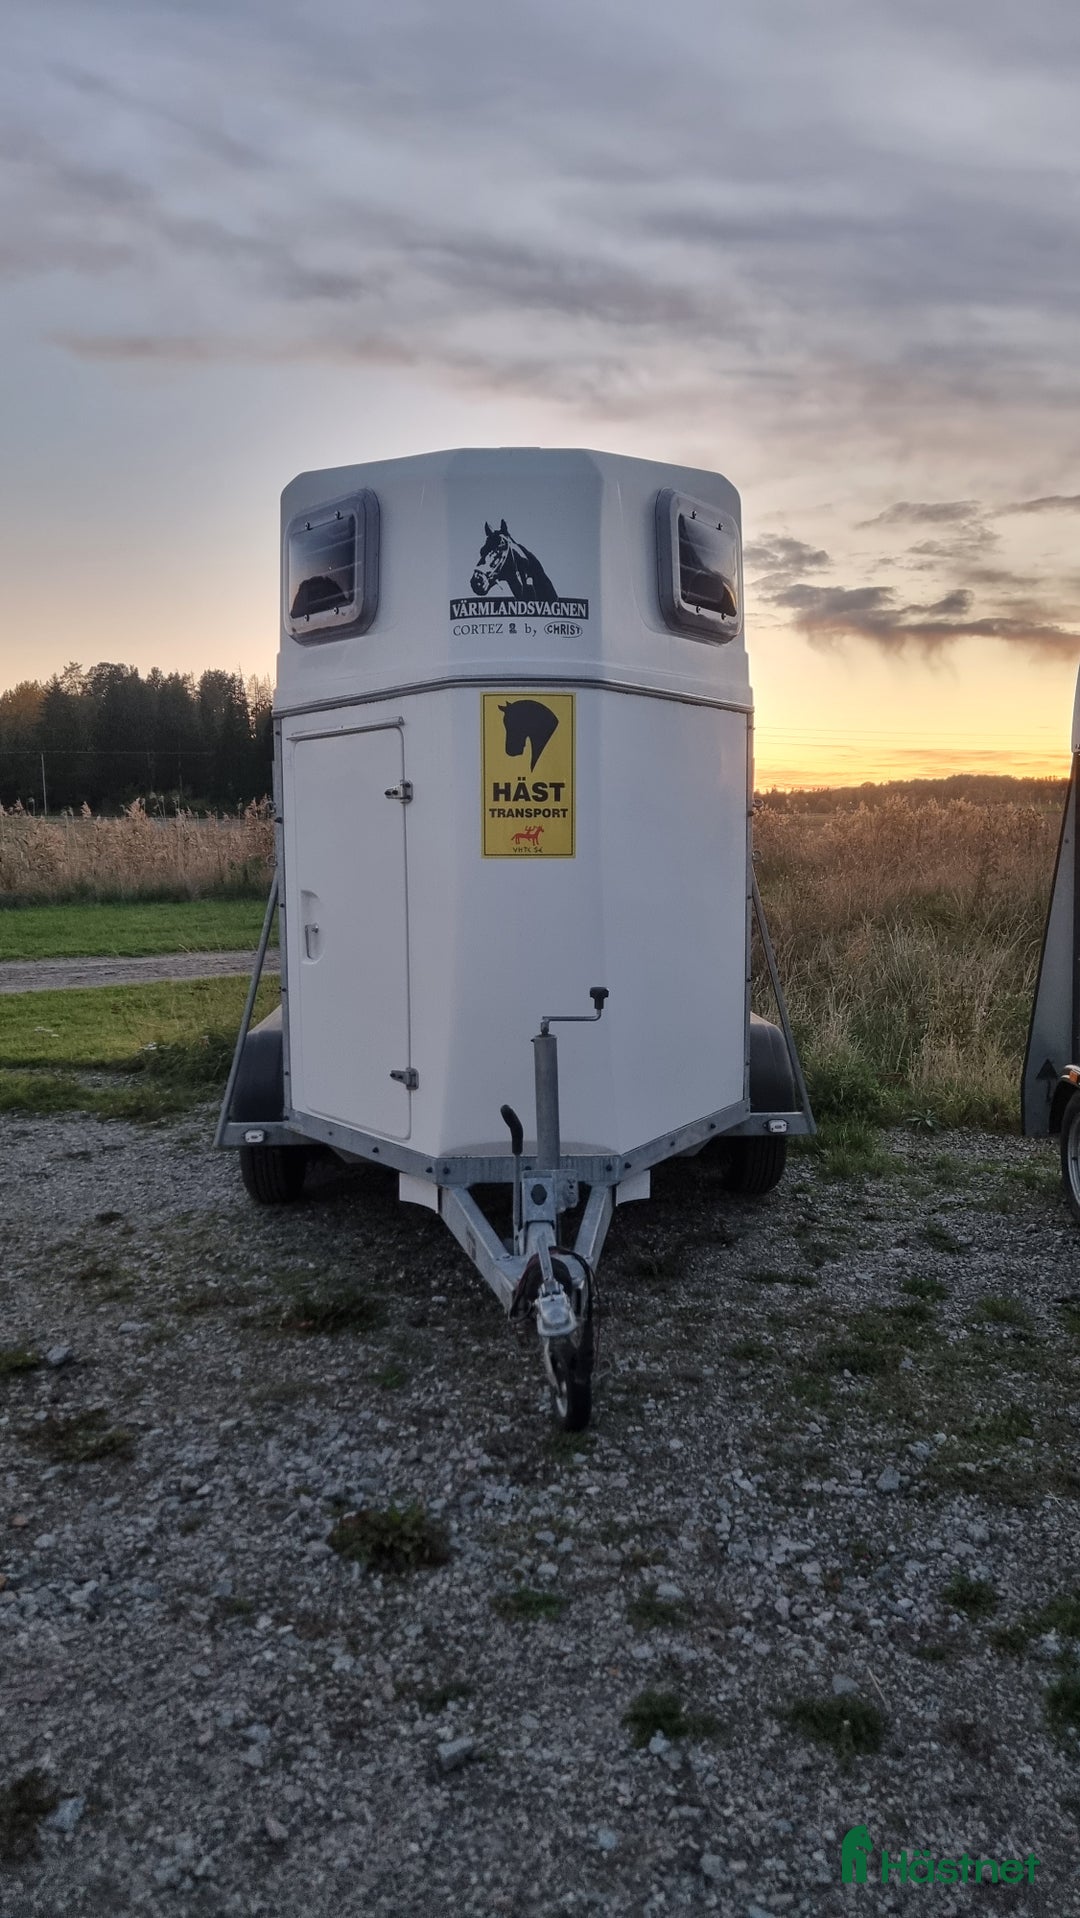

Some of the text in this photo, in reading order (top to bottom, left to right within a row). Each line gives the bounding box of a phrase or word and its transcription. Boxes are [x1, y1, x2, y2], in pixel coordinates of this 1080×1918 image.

[452, 600, 587, 617] VÄRMLANDSVAGNEN
[453, 623, 503, 636] CORTEZ
[546, 623, 580, 635] CHRIST
[492, 776, 565, 802] HÄST
[489, 808, 568, 818] TRANSPORT
